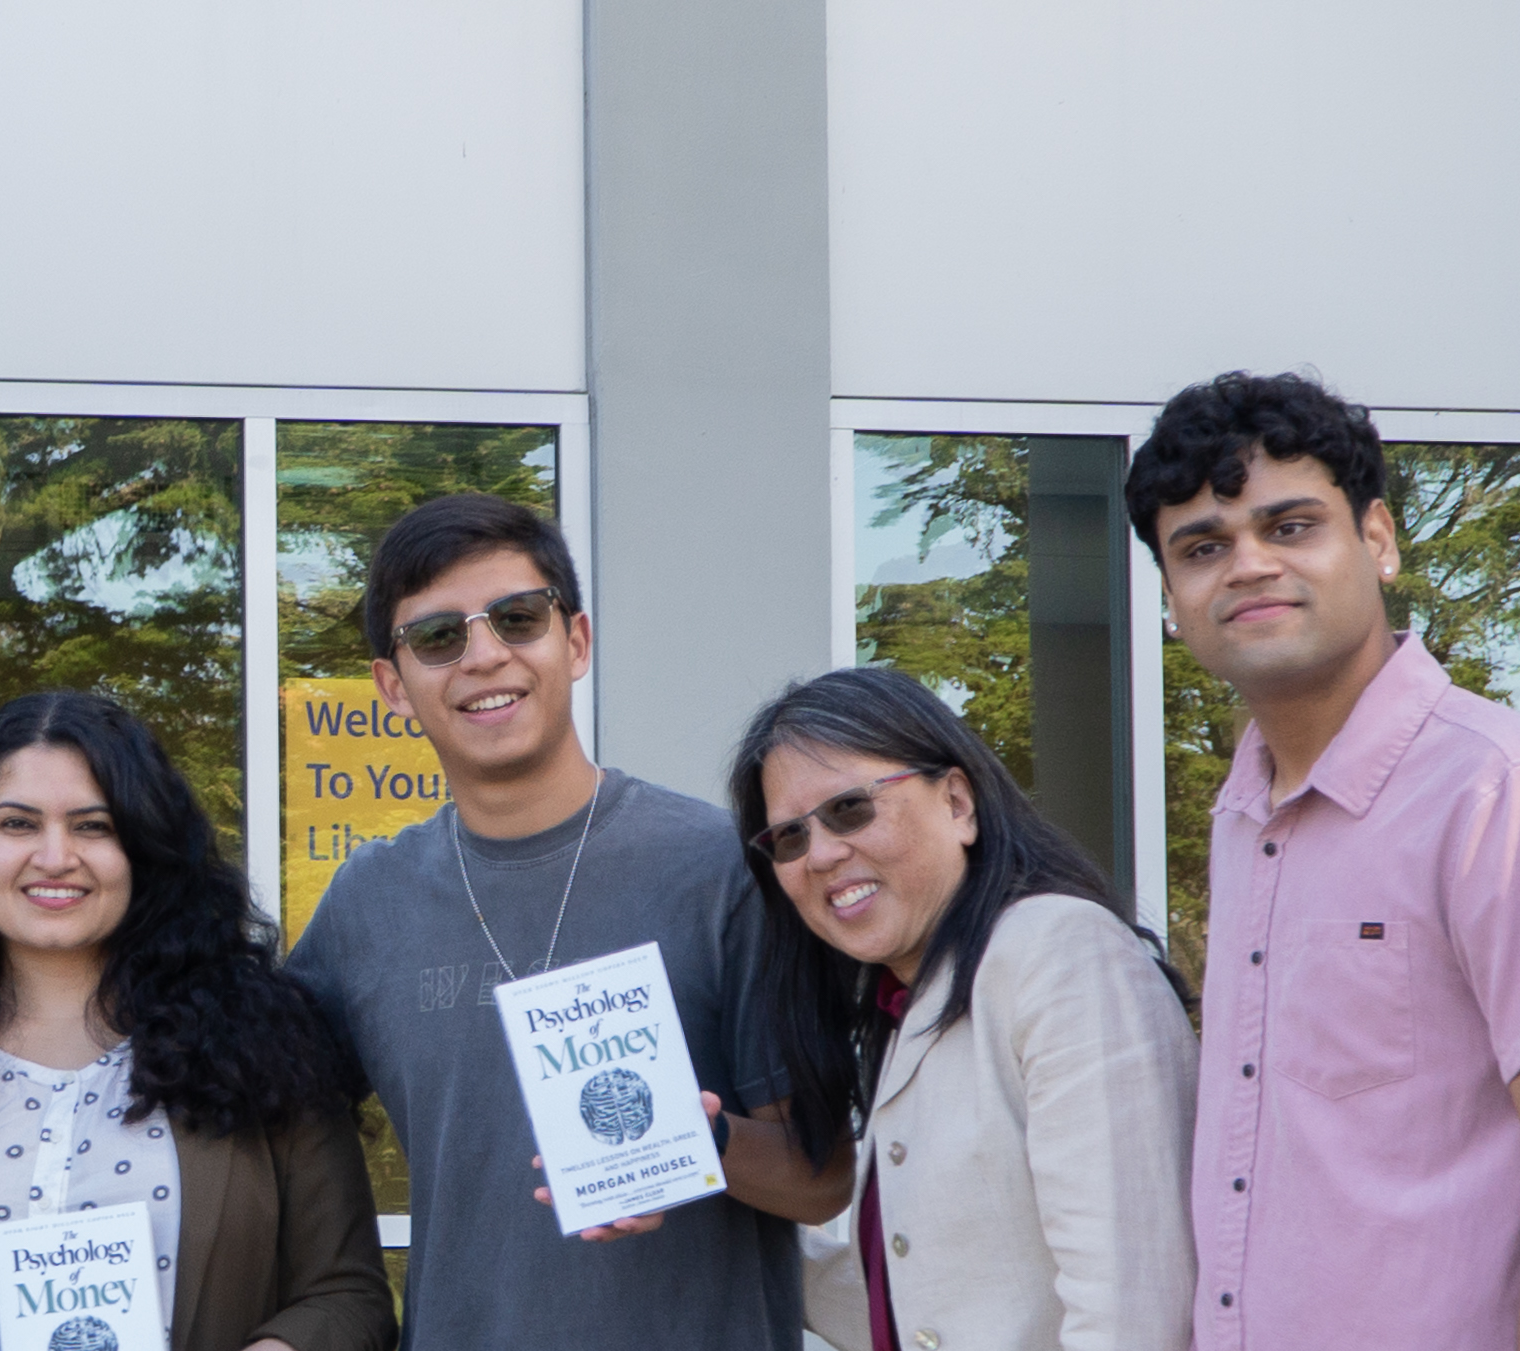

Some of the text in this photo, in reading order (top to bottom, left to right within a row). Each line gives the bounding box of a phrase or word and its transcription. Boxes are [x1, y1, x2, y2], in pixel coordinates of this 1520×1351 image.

[305, 700, 426, 739] Welco
[305, 763, 354, 800] To
[574, 982, 592, 996] The
[524, 984, 652, 1034] Psychology
[589, 1018, 604, 1039] of
[533, 1023, 661, 1081] Money
[575, 1172, 637, 1198] MORGAN
[640, 1154, 698, 1179] HOUSEL
[62, 1230, 79, 1241] The
[11, 1239, 134, 1276] Psychology
[69, 1266, 85, 1285] of
[14, 1278, 138, 1319] Money
